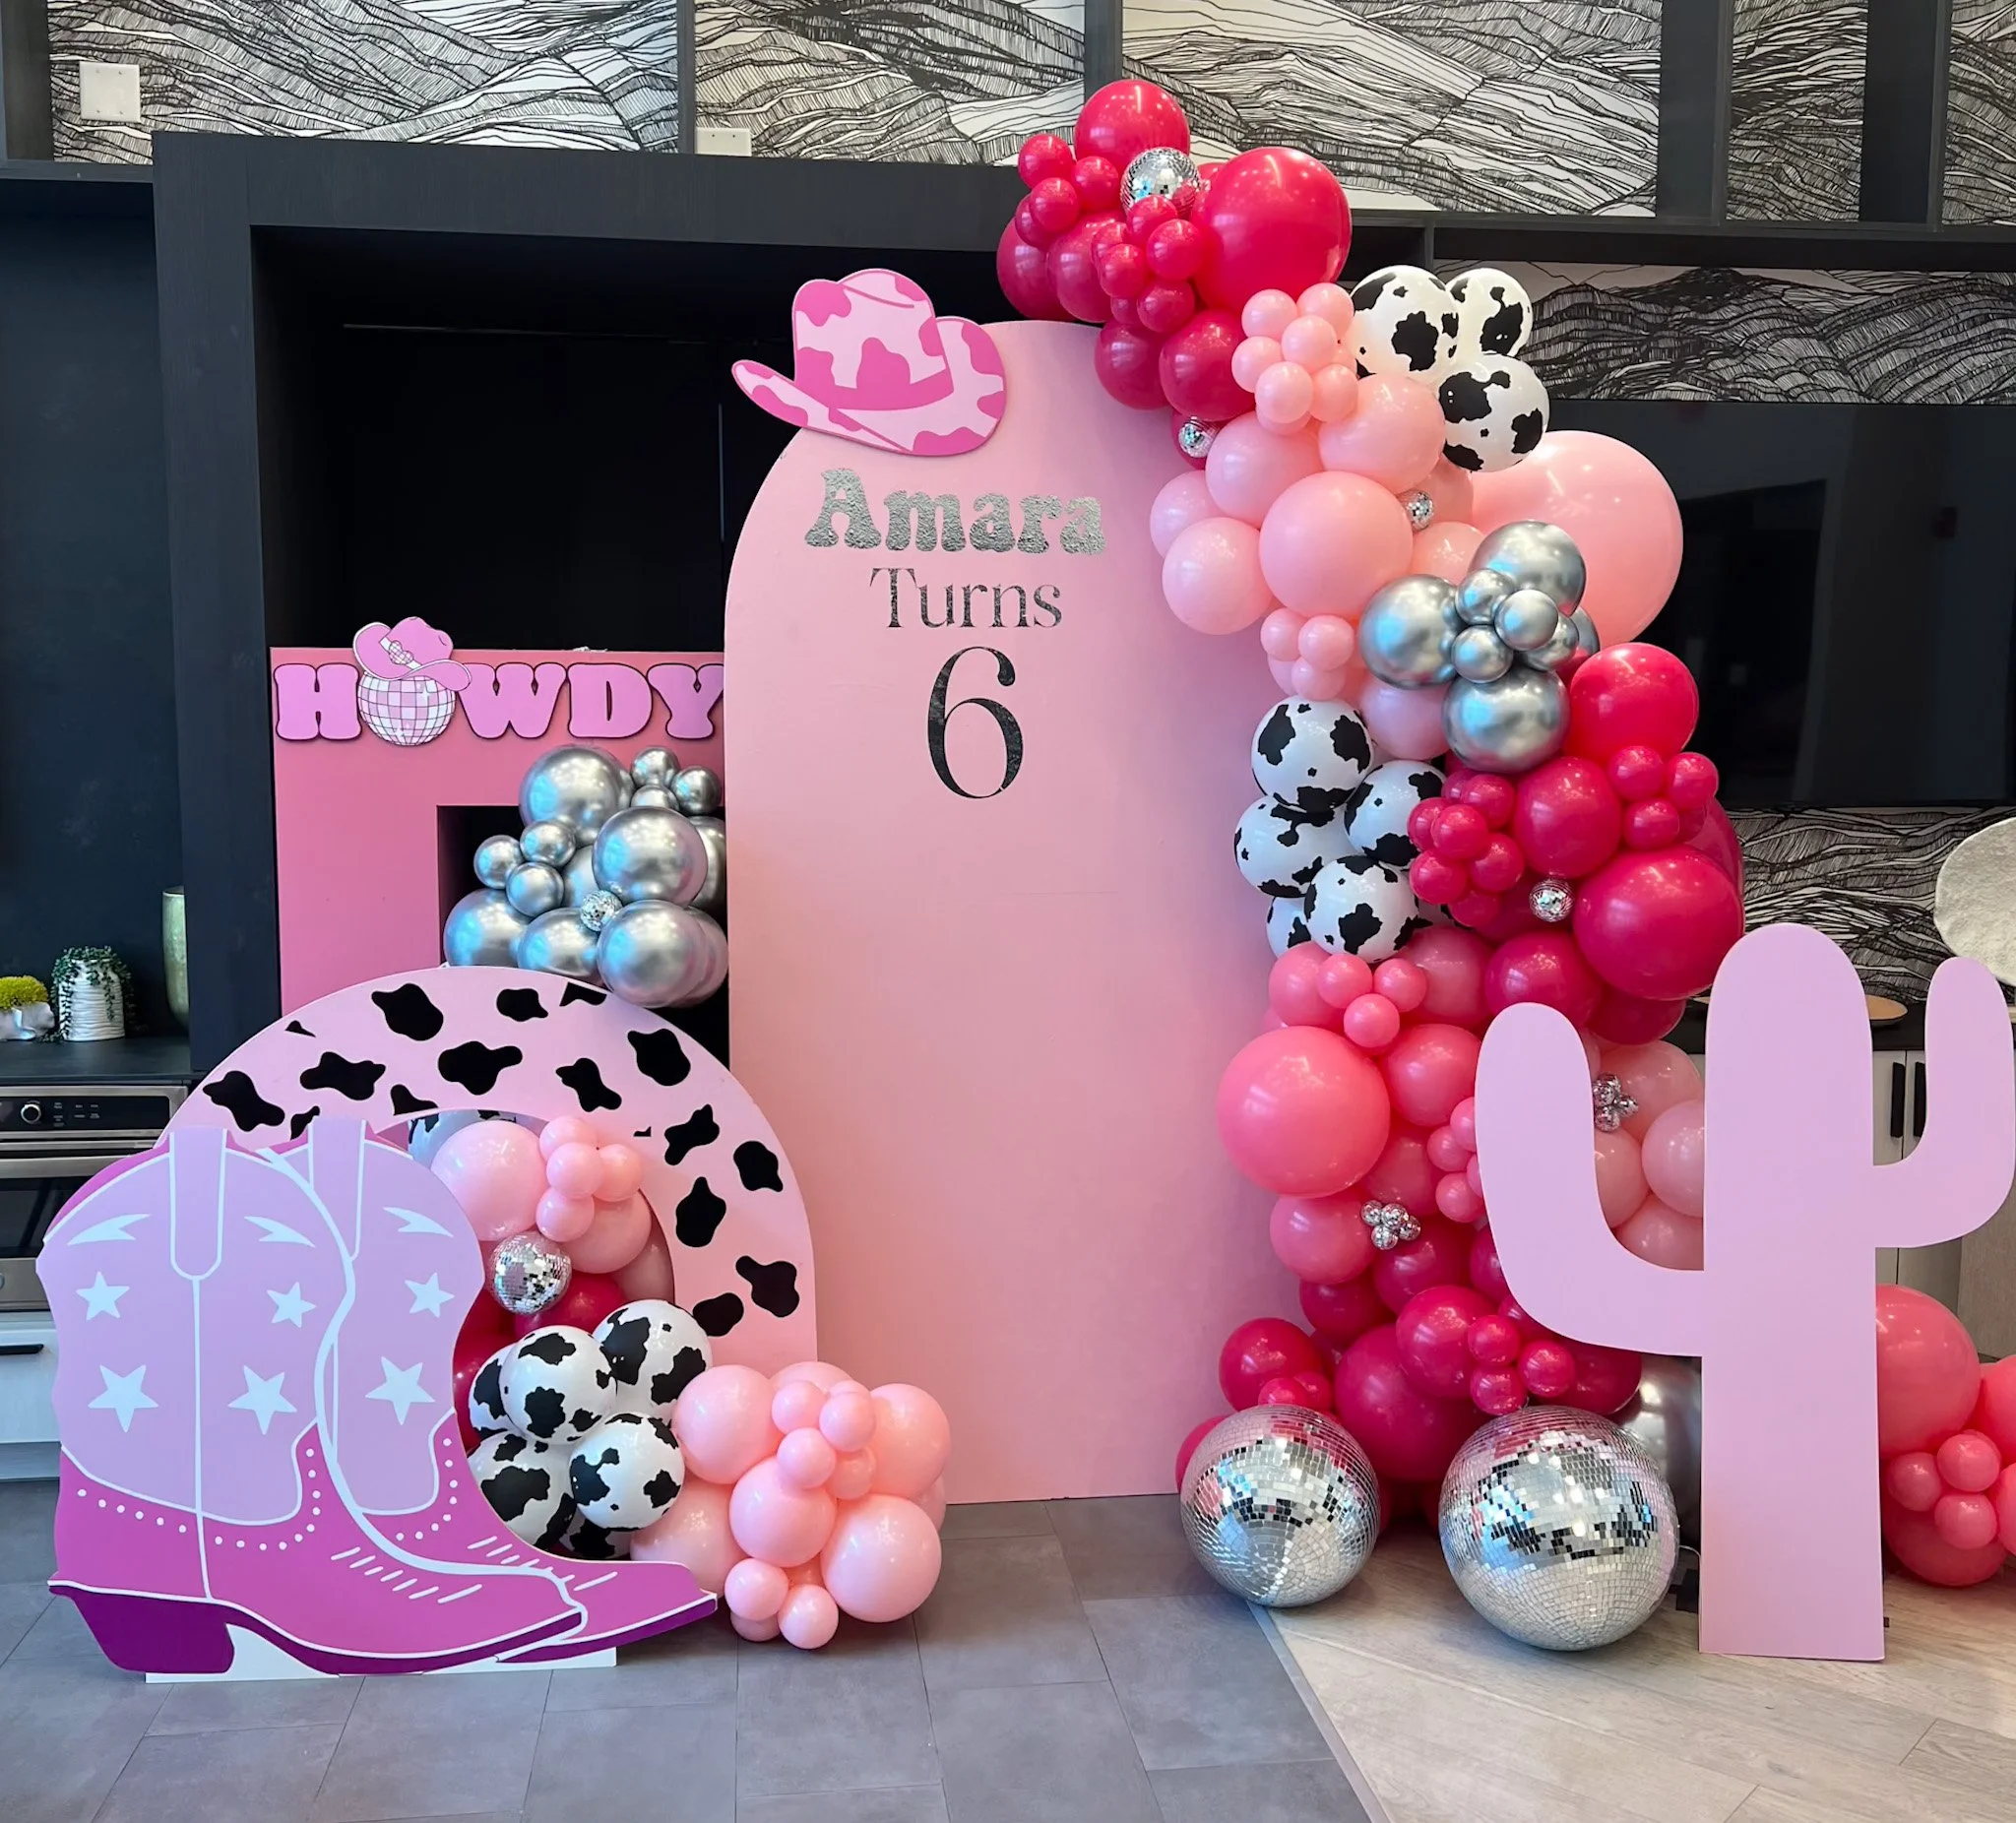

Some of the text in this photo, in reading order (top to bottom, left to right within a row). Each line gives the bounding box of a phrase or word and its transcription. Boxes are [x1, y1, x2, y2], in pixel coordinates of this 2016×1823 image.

[804, 468, 1106, 555] Amara
[869, 567, 1063, 628] Turns
[274, 661, 724, 746] HOWDY
[927, 646, 1024, 799] 6
